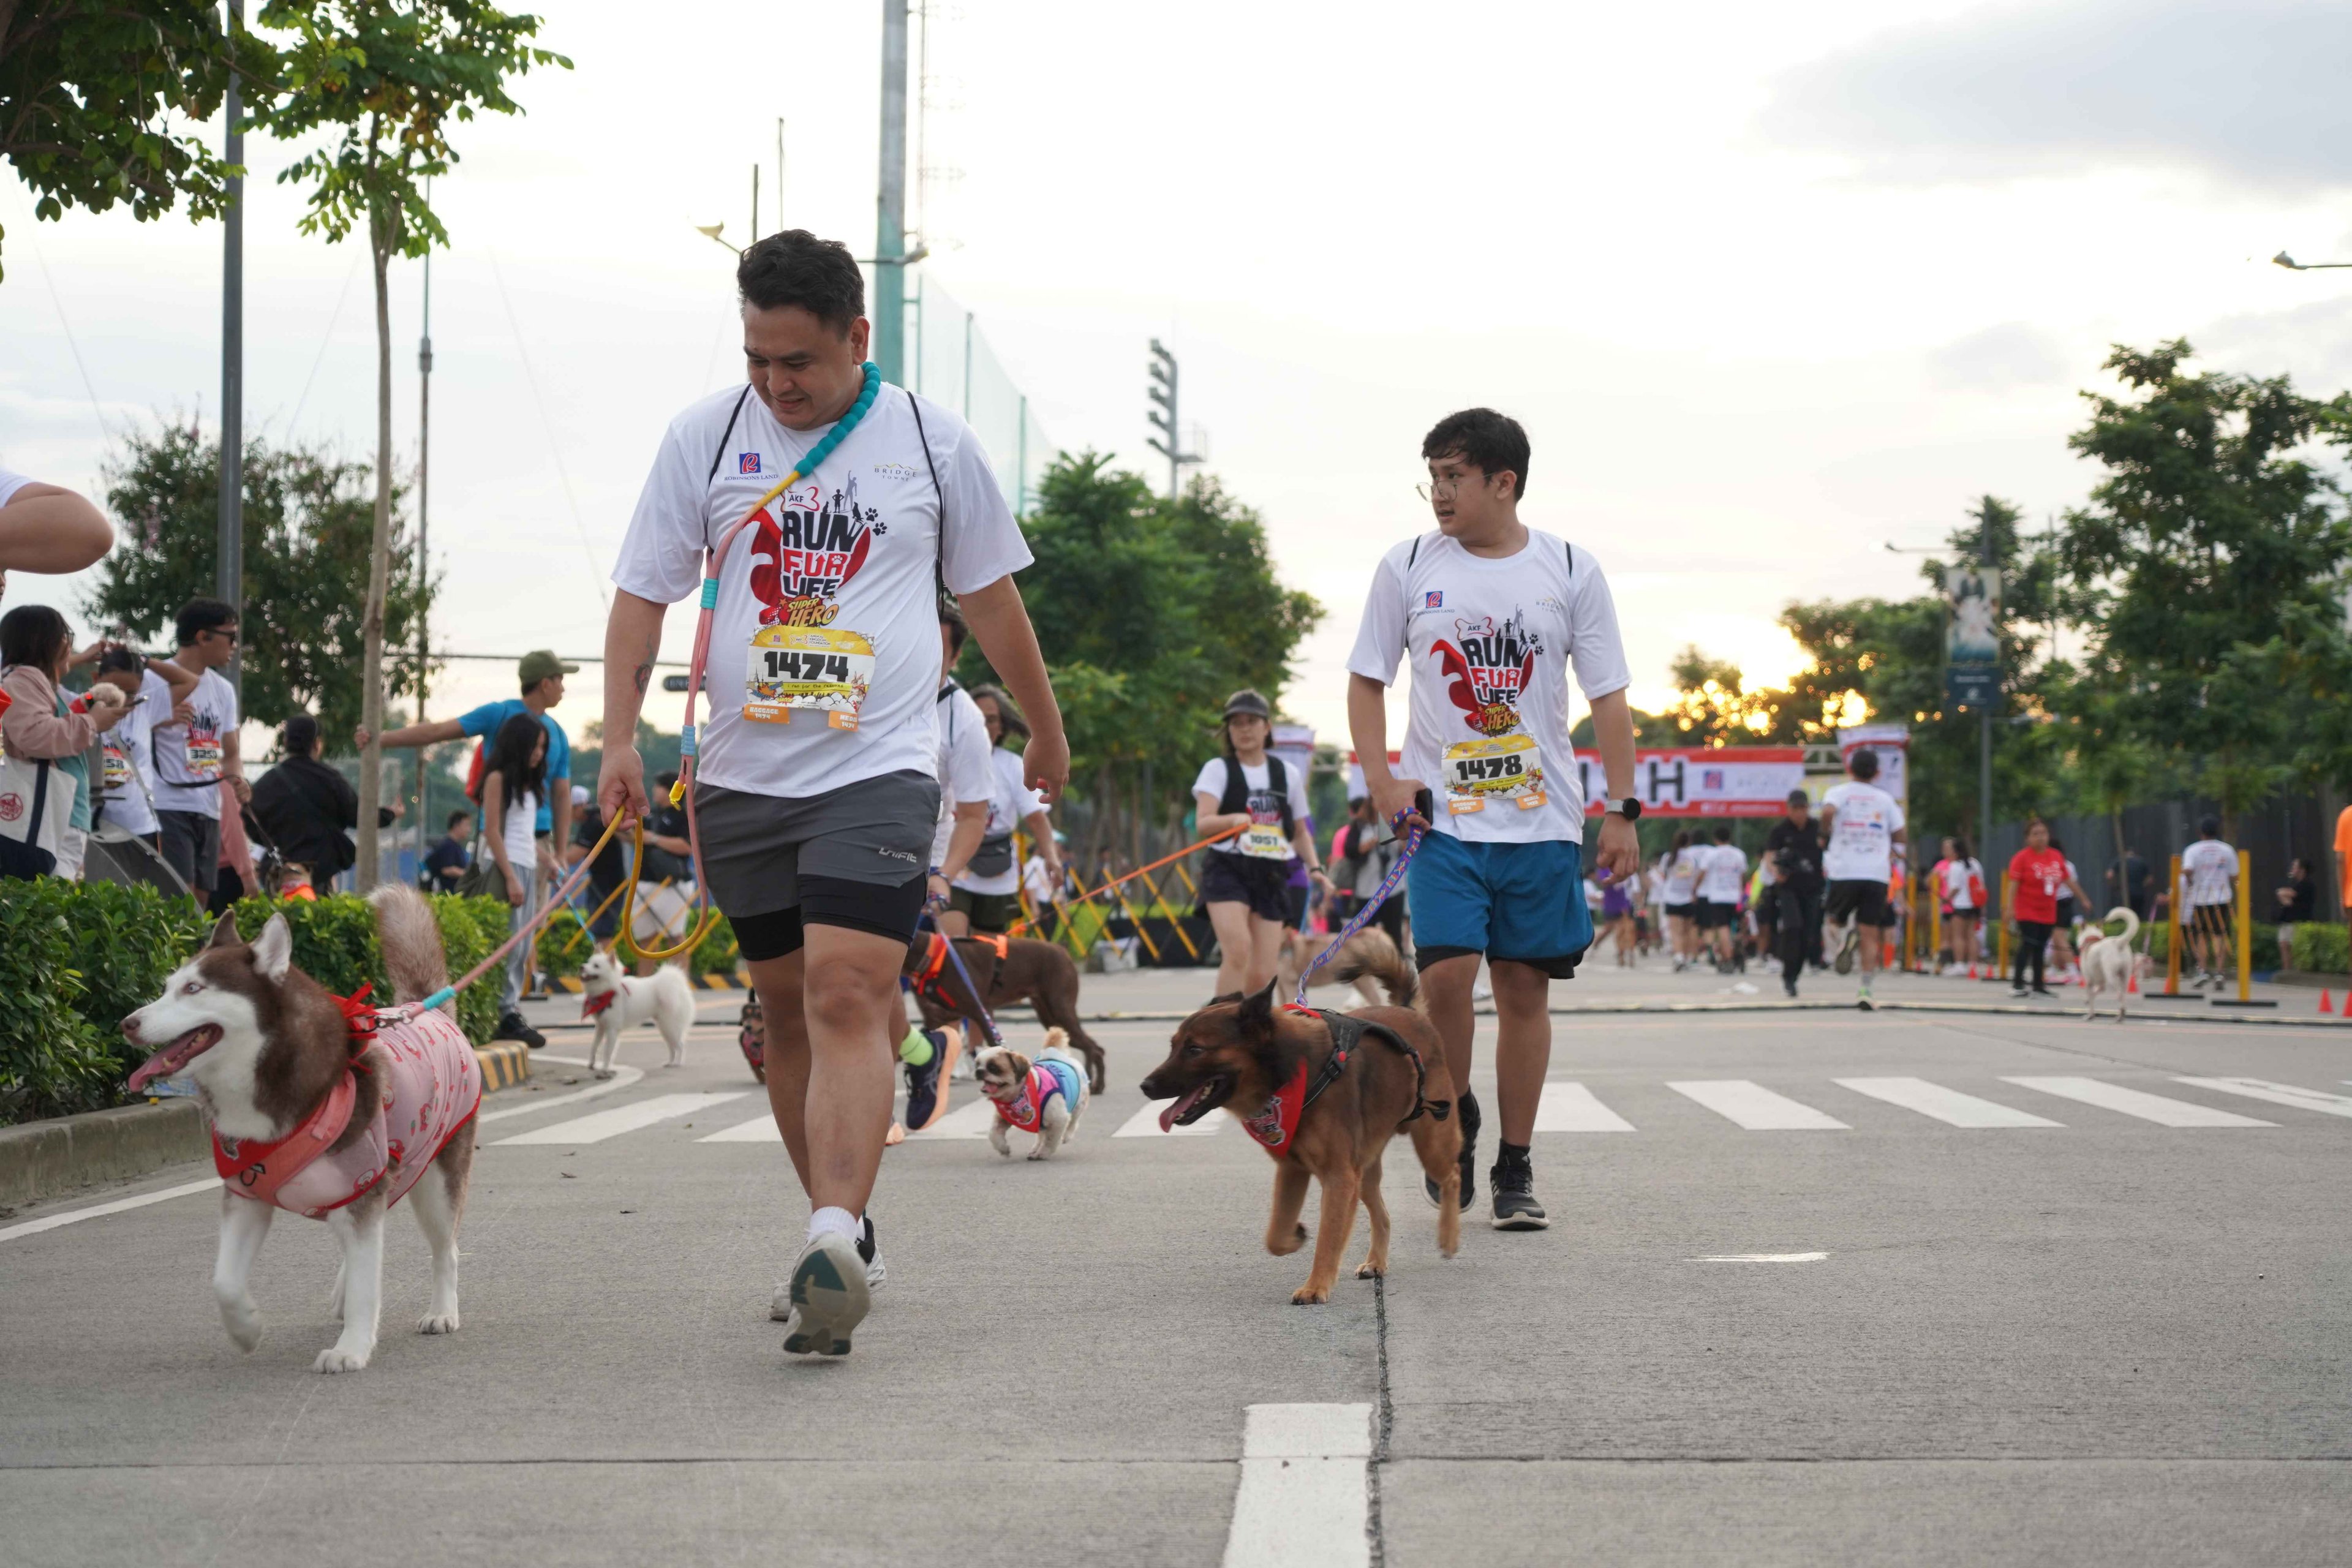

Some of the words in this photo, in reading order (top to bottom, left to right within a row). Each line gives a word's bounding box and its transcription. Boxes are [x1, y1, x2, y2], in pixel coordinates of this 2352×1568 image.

[874, 467, 917, 477] BRIDGE
[782, 511, 862, 552] RUN
[783, 548, 848, 577] FUR
[783, 575, 841, 597] LIFE
[787, 597, 820, 612] SUPER
[787, 603, 839, 627] HERO
[1460, 636, 1529, 668] RUN
[764, 651, 848, 682] 1474
[1471, 668, 1520, 688] FUR
[1475, 688, 1518, 704] LIFE
[1485, 705, 1507, 717] SUPER
[1487, 710, 1521, 730] HERO
[1456, 755, 1522, 780] 1478
